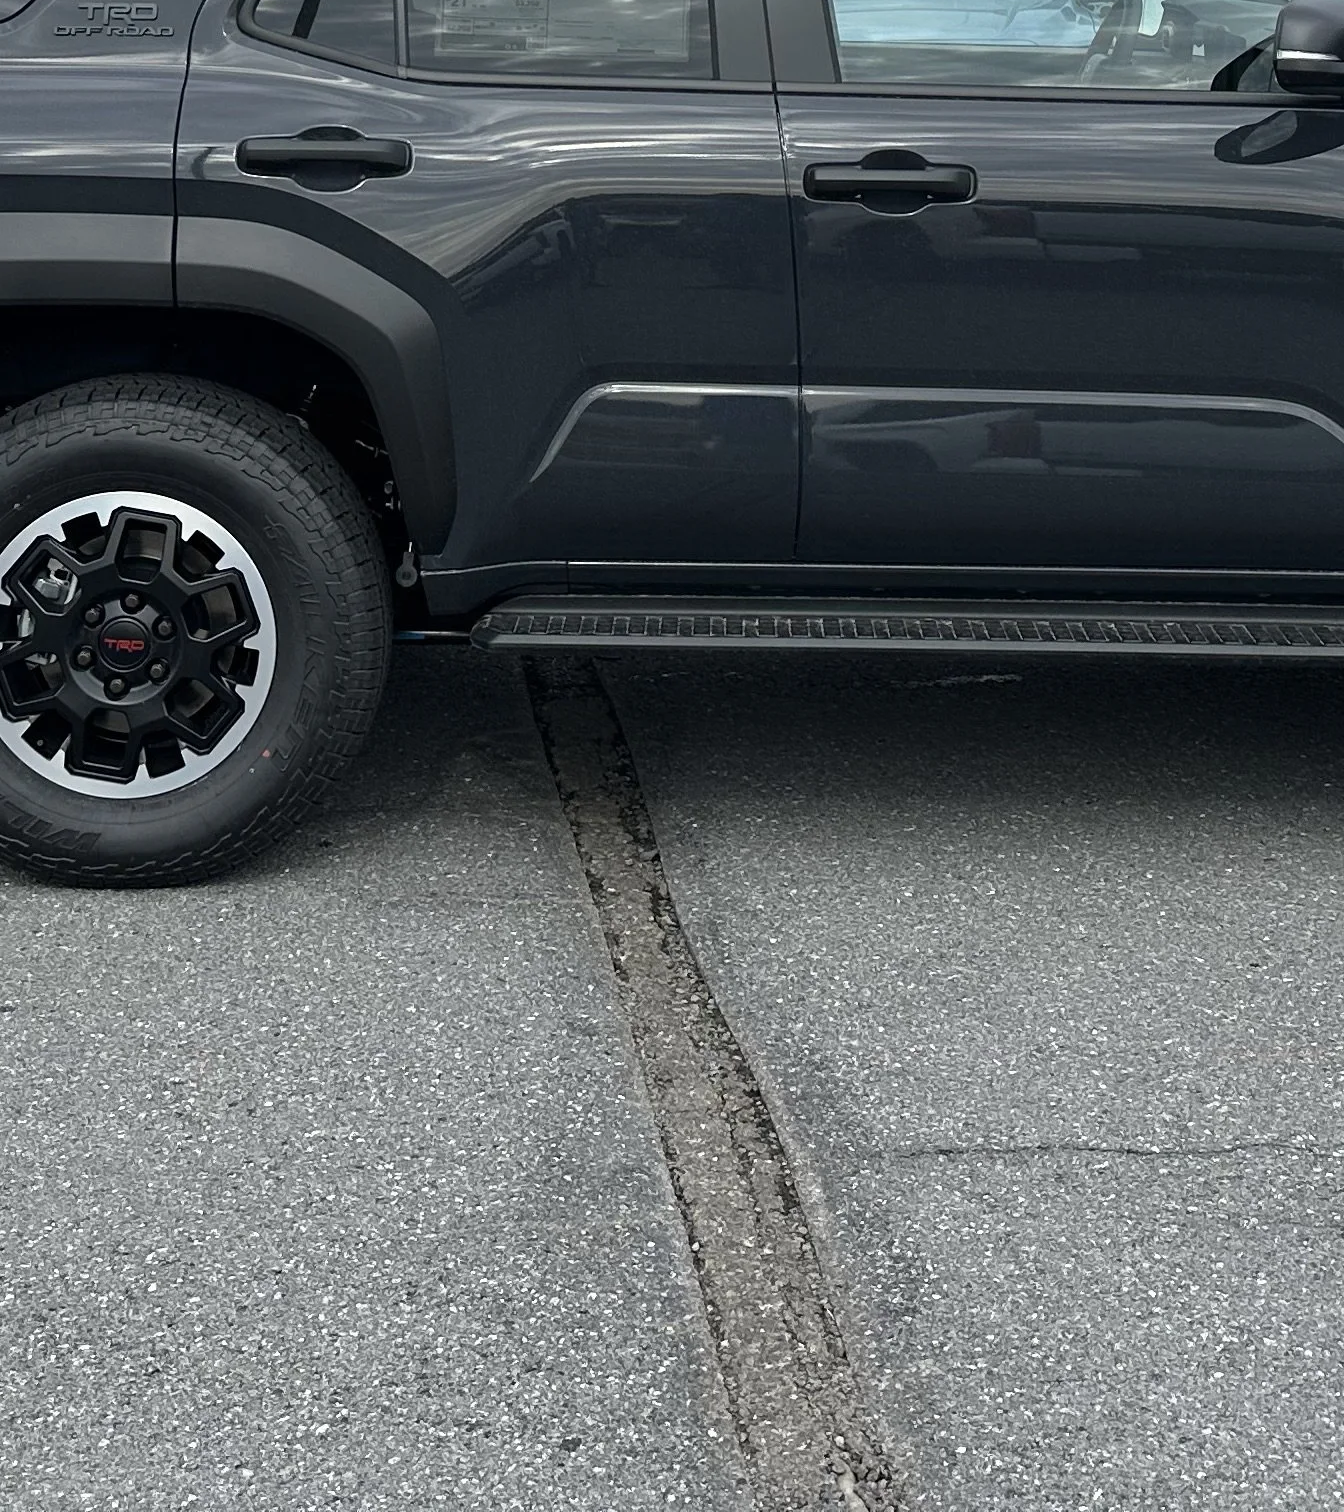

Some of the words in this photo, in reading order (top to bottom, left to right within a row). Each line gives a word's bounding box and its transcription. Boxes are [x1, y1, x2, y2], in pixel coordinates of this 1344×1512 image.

[77, 2, 158, 26] TRD
[53, 25, 103, 37] OFF
[106, 25, 175, 37] ROAD
[103, 638, 145, 653] TRD
